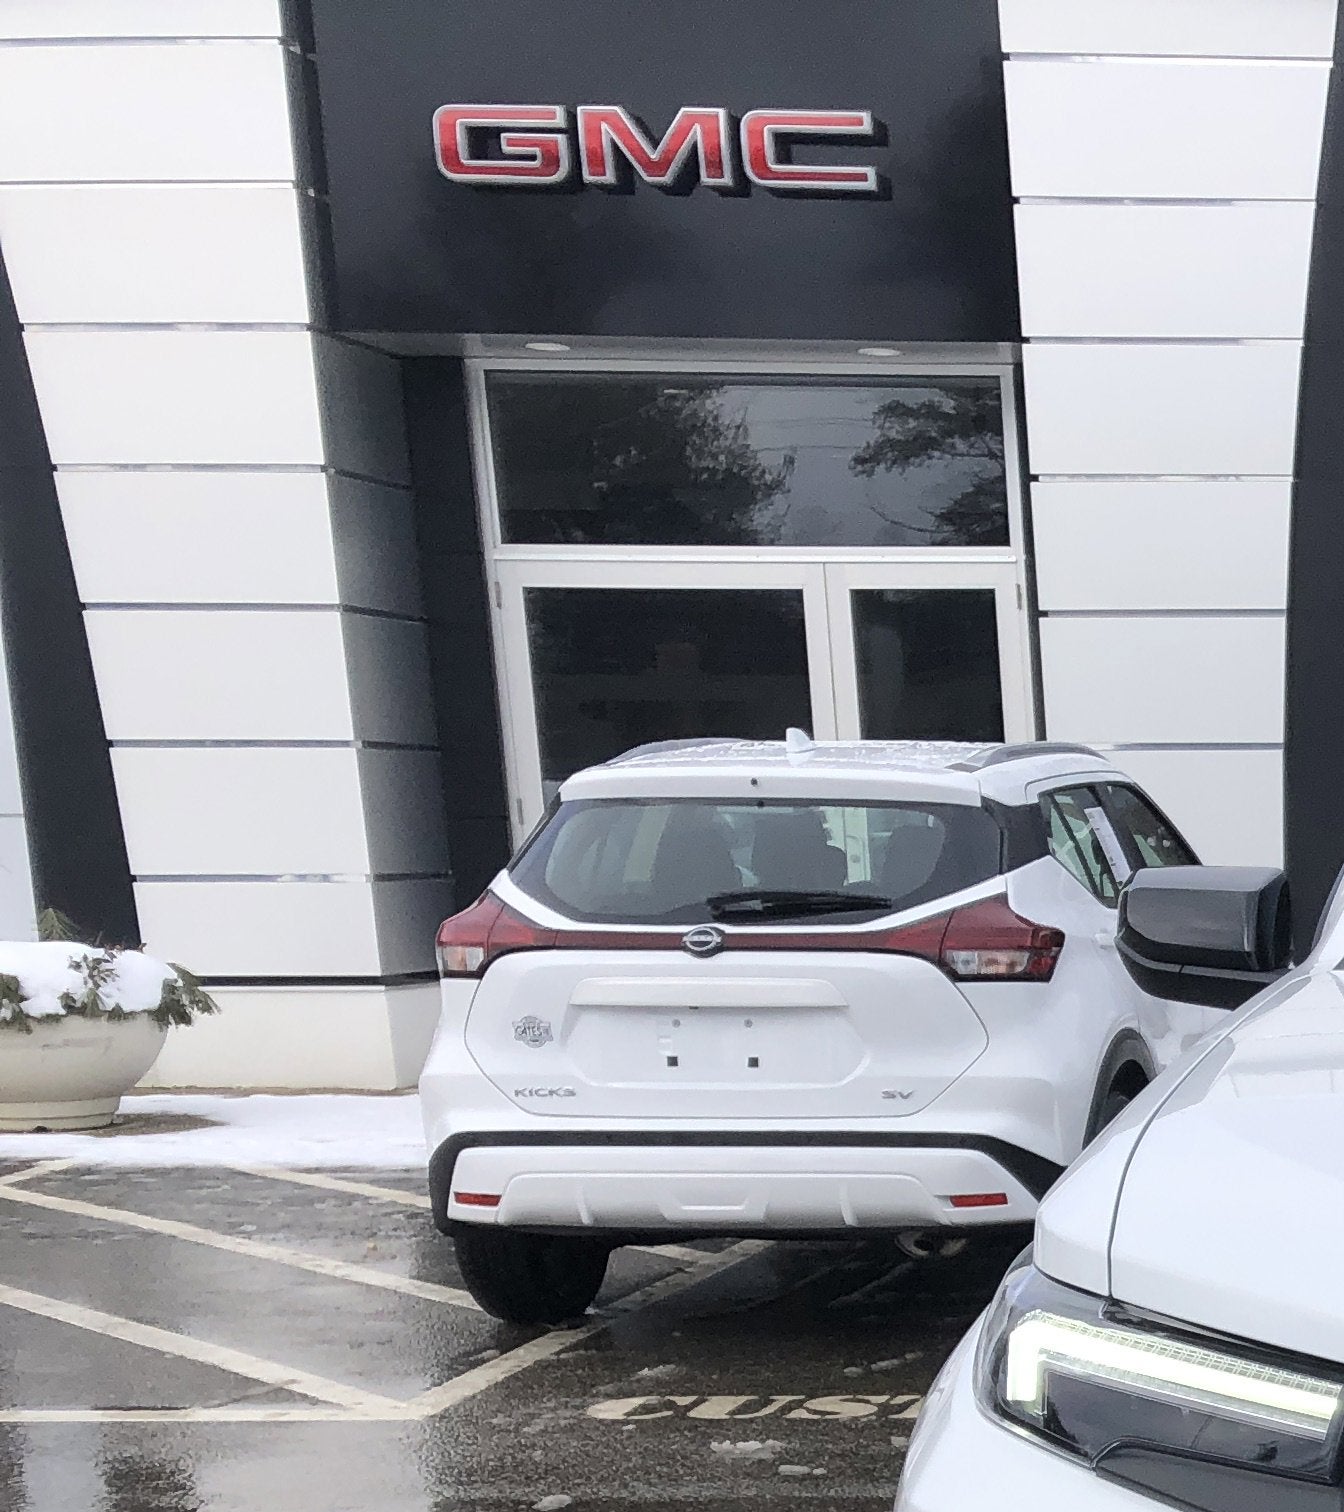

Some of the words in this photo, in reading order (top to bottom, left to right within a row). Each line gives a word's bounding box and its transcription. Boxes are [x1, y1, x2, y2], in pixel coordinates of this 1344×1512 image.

[433, 104, 877, 191] GMC
[514, 1087, 577, 1098] KICKS
[881, 1090, 914, 1100] SV
